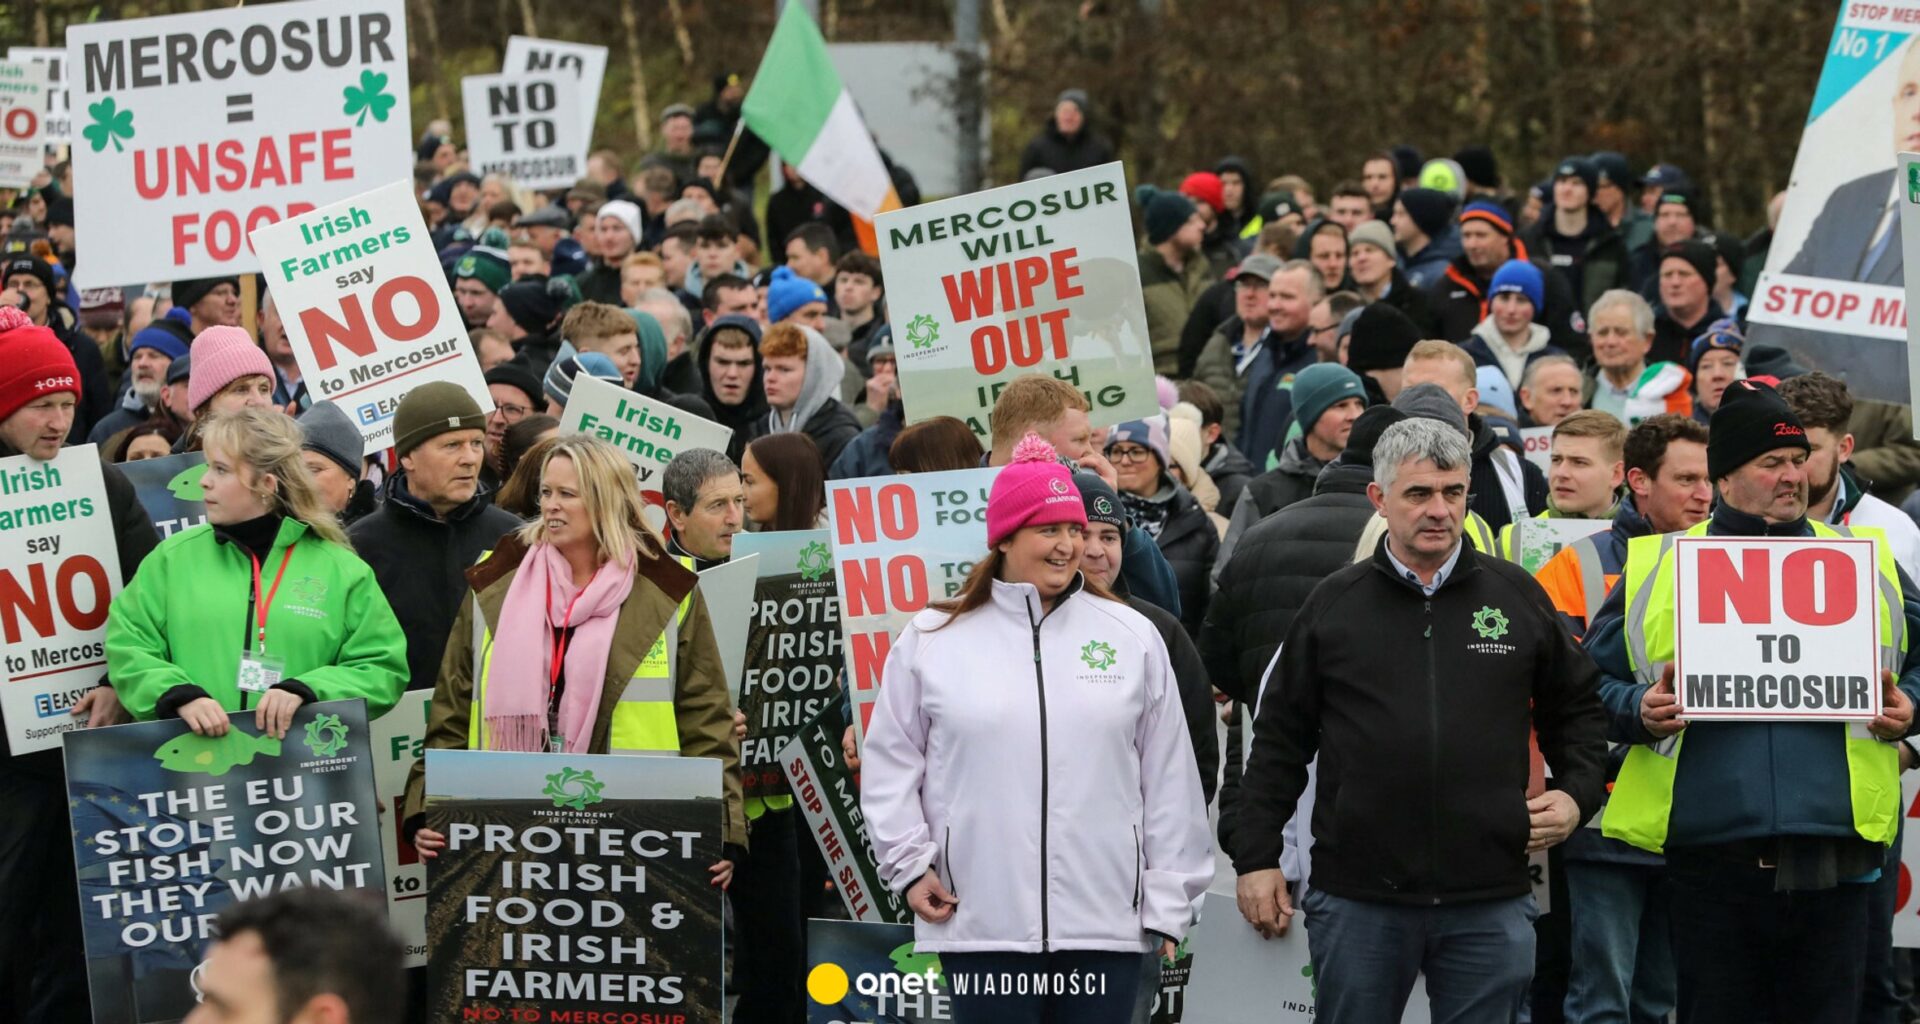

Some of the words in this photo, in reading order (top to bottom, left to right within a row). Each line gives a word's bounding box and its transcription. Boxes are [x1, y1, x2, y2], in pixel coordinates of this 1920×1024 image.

[1850, 3, 1888, 20] STOP
[84, 12, 395, 93] MERCOSUR
[1832, 28, 1868, 58] No
[1874, 33, 1891, 60] 1
[489, 82, 556, 116] NO
[493, 120, 556, 152] TO
[134, 128, 355, 200] UNSAFE
[300, 207, 372, 245] Irish
[889, 181, 1118, 250] MERCOSUR
[280, 226, 411, 282] Farmers
[960, 225, 1054, 261] WILL
[336, 265, 375, 289] say
[941, 247, 1084, 323] WIPE
[1764, 285, 1859, 322] STOP
[298, 275, 440, 372] NO
[970, 308, 1070, 376] OUT
[320, 377, 344, 395] to
[349, 336, 458, 385] Mercosur
[615, 399, 682, 440] Irish
[1, 462, 62, 495] Irish
[832, 483, 919, 545] NO
[932, 490, 969, 506] TO
[27, 534, 61, 555] say
[0, 554, 111, 645] NO
[790, 581, 835, 589] INDEPENDENT
[842, 554, 929, 617] NO
[1697, 547, 1857, 626] NO
[5, 652, 26, 673] to
[1467, 643, 1516, 651] INDEPENDENT
[1756, 634, 1801, 664] TO
[744, 664, 834, 695] FOOD
[1686, 674, 1869, 710] MERCOSUR
[300, 756, 358, 768] INDEPENDENT
[812, 725, 835, 769] TO
[312, 764, 347, 773] IRELAND
[138, 784, 227, 818] THE
[246, 775, 304, 806] EU
[790, 757, 823, 814] STOP
[818, 817, 845, 865] THE
[95, 815, 237, 855] STOLE
[254, 801, 360, 836] OUR
[533, 810, 614, 819] INDEPENDENT
[548, 816, 599, 825] IRELAND
[450, 823, 702, 858] PROTECT
[108, 851, 212, 886] FISH
[230, 833, 353, 872] NOW
[502, 861, 646, 893] IRISH
[93, 882, 214, 920] THEY
[228, 862, 372, 902] WANT
[393, 875, 420, 893] to
[466, 896, 626, 928] FOOD
[651, 902, 685, 930] &
[502, 933, 647, 965] IRISH
[465, 969, 685, 1004] FARMERS
[463, 1007, 500, 1022] NO
[510, 1008, 541, 1023] TO
[551, 1010, 686, 1024] MERCOSUR
[870, 992, 951, 1020] THE
